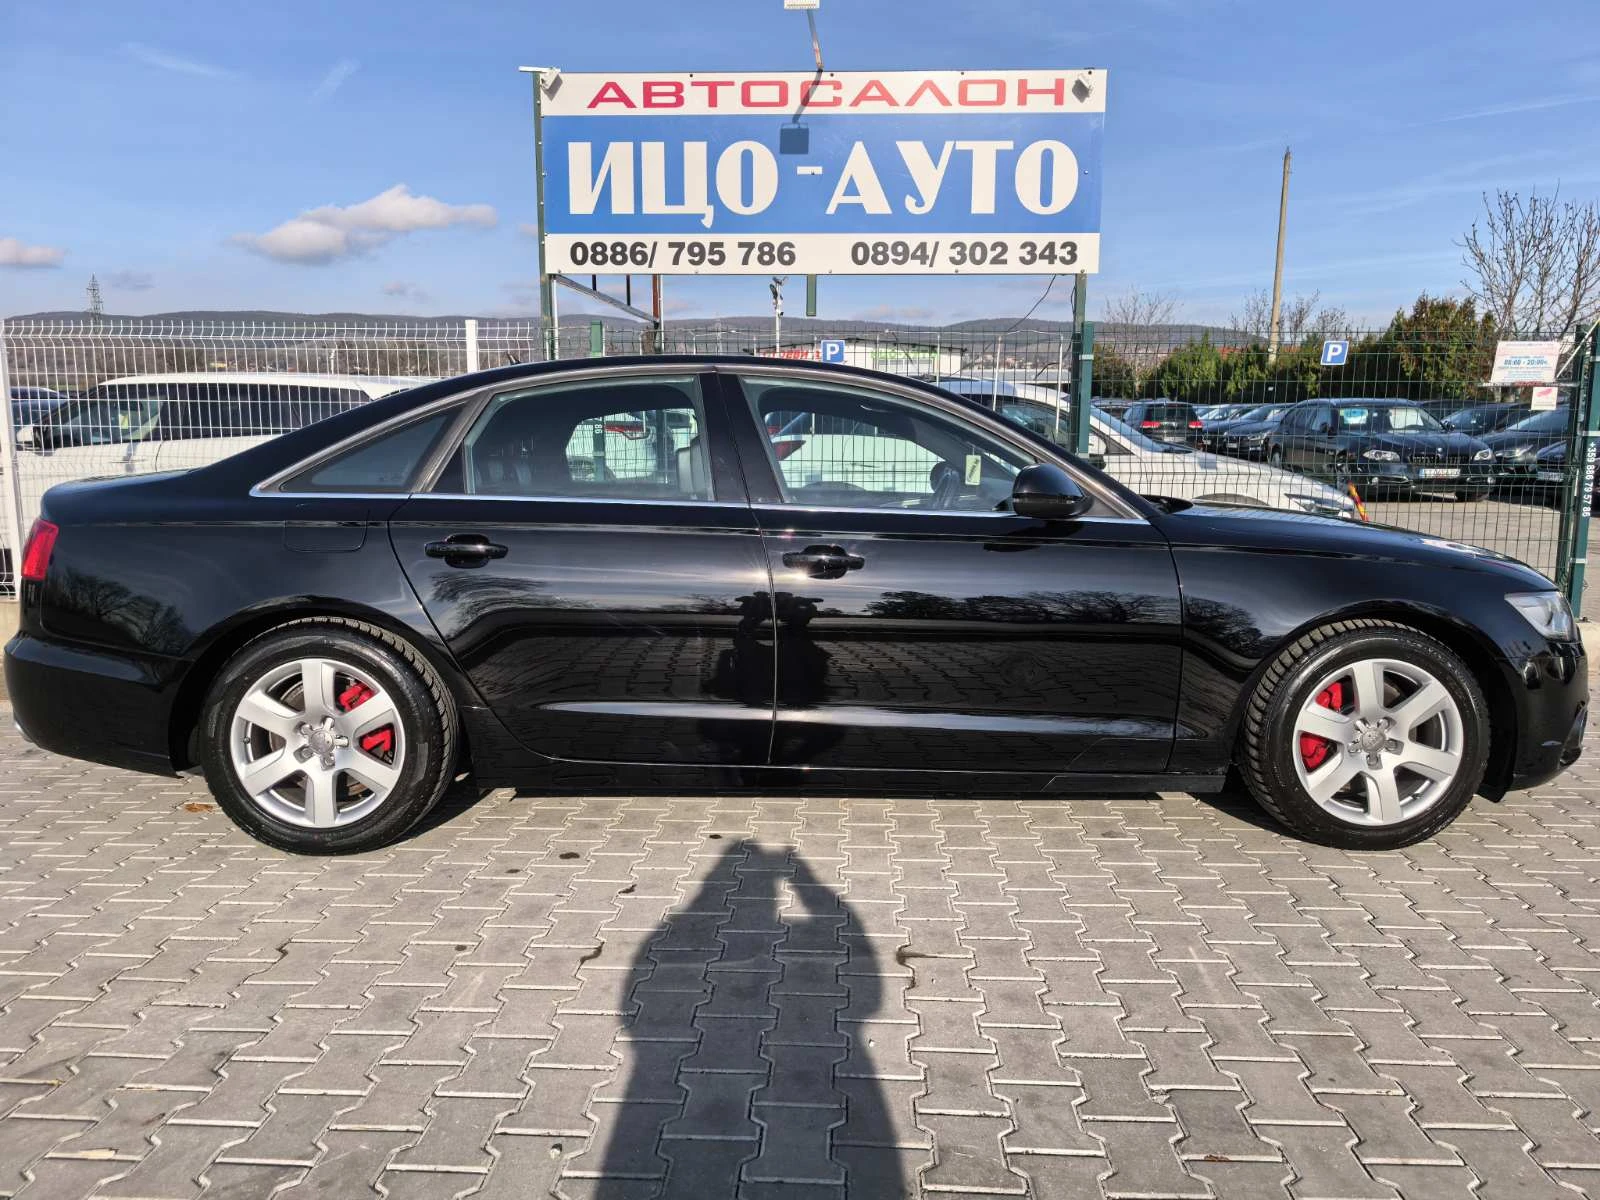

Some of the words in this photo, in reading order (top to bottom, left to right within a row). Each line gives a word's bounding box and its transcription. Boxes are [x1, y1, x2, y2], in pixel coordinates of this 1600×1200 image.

[586, 78, 1065, 110] АВТОСАЛОН
[569, 241, 658, 268] 0886/
[667, 241, 726, 266] 795
[737, 241, 796, 266] 786
[850, 240, 940, 268] 0894/
[948, 240, 1009, 266] 302
[1018, 240, 1078, 266] 343
[826, 343, 840, 361] P
[1327, 344, 1343, 361] P
[1586, 441, 1597, 463] +359
[1585, 464, 1595, 480] 886
[1583, 481, 1594, 493] 79
[1583, 494, 1593, 505] 57
[1582, 506, 1592, 517] 86
